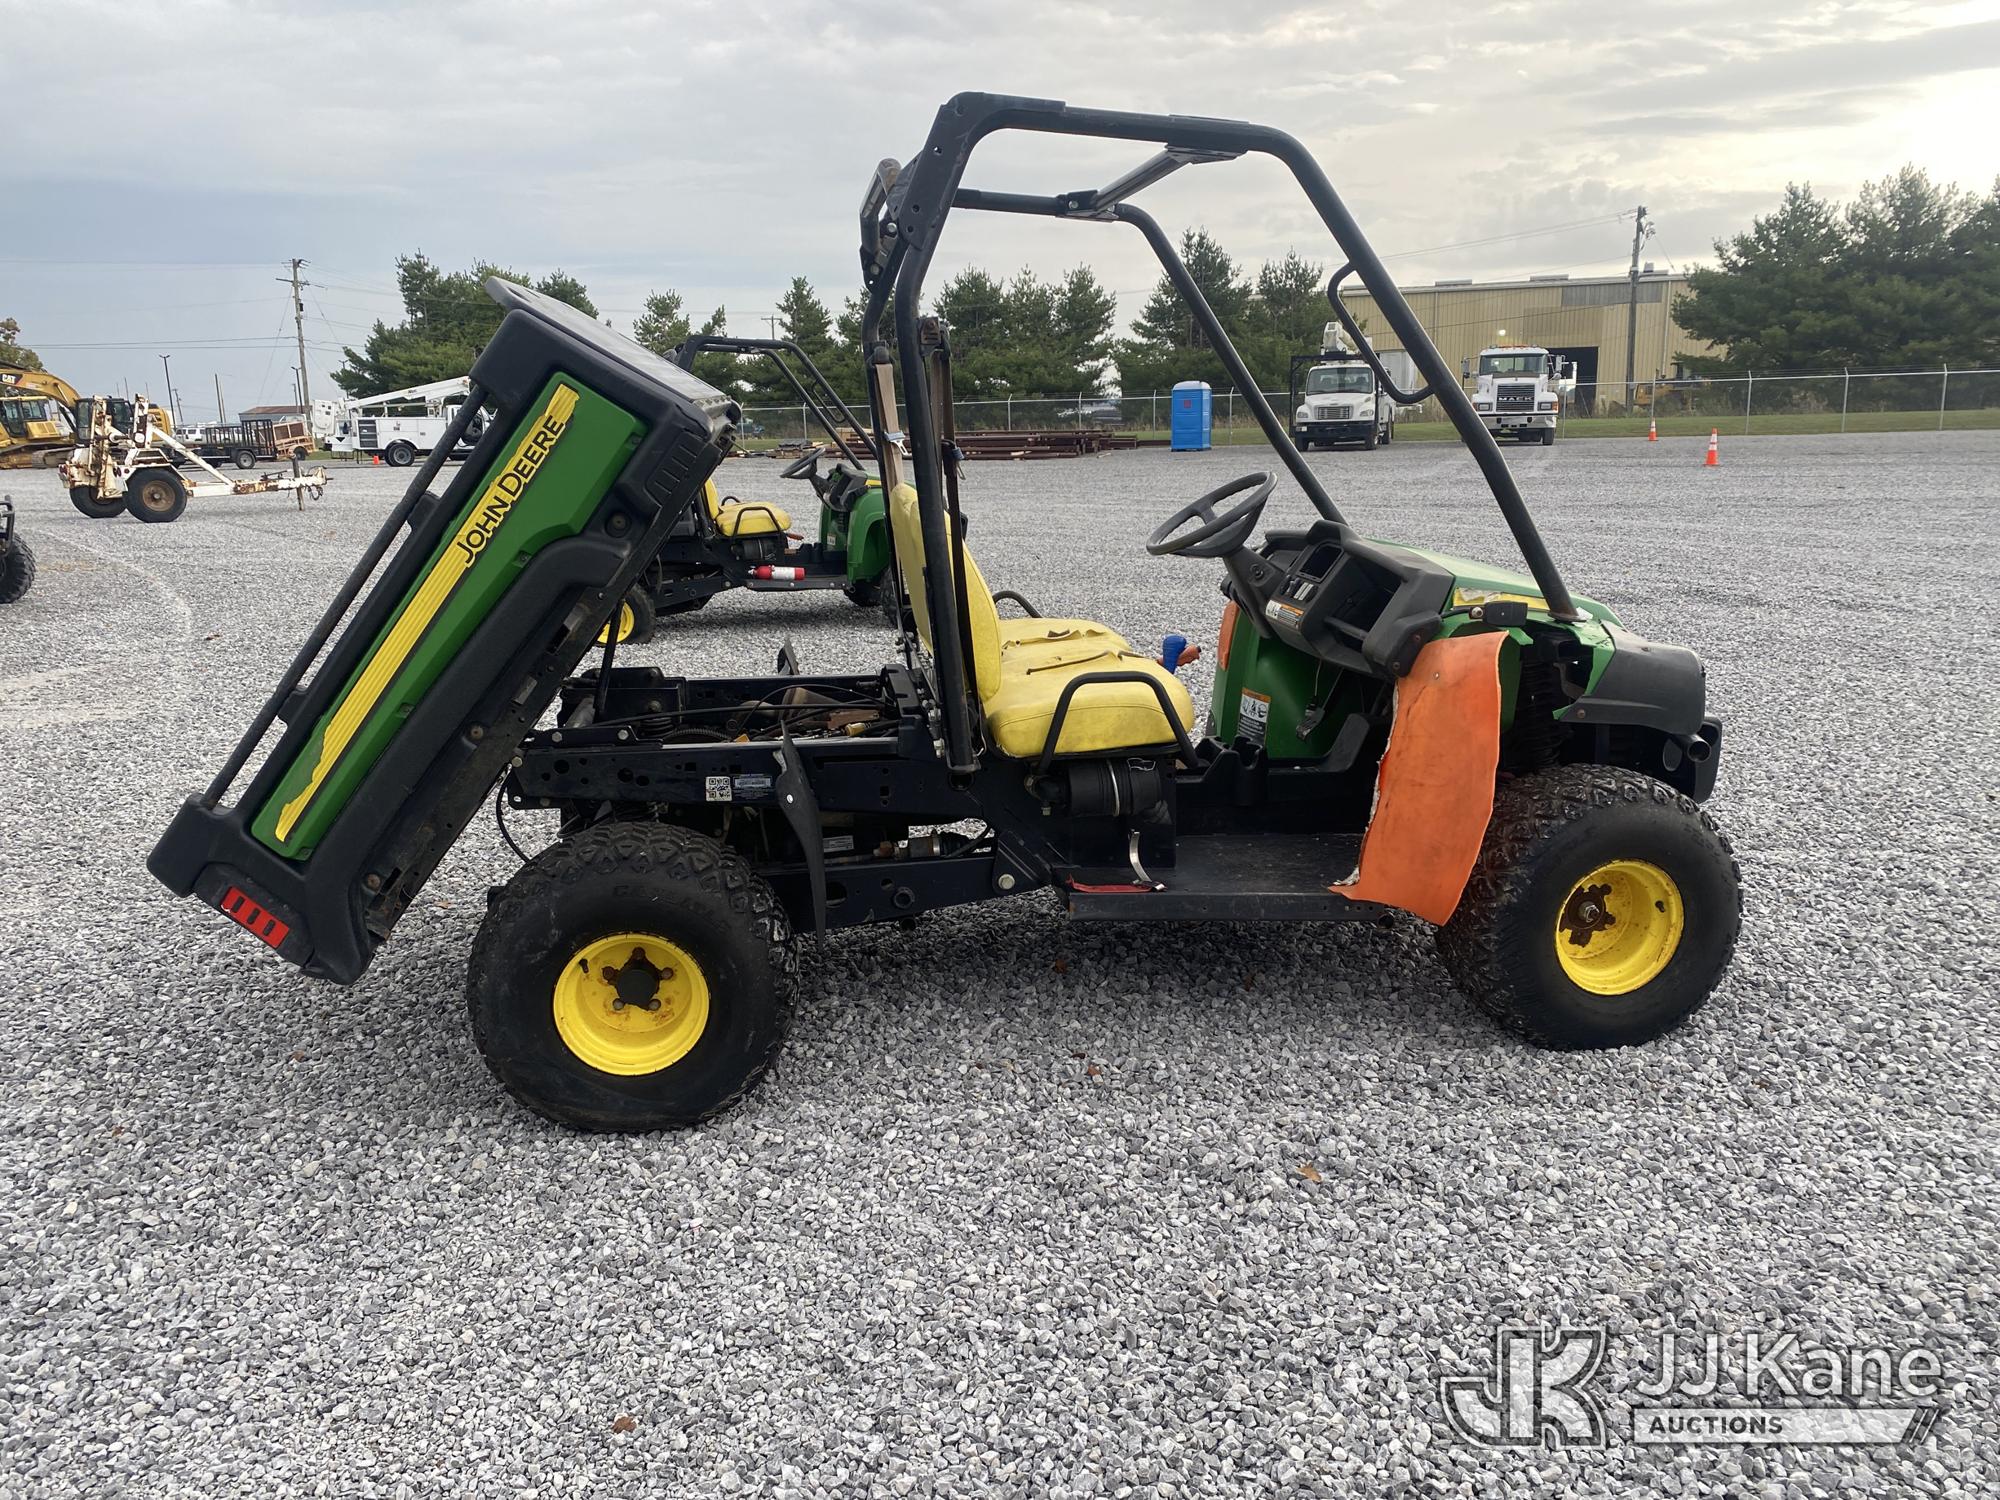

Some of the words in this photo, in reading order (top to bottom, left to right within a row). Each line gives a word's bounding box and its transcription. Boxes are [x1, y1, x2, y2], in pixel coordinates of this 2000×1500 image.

[2, 373, 16, 384] CAT
[456, 495, 511, 564] JOHN
[497, 415, 564, 497] DEERE
